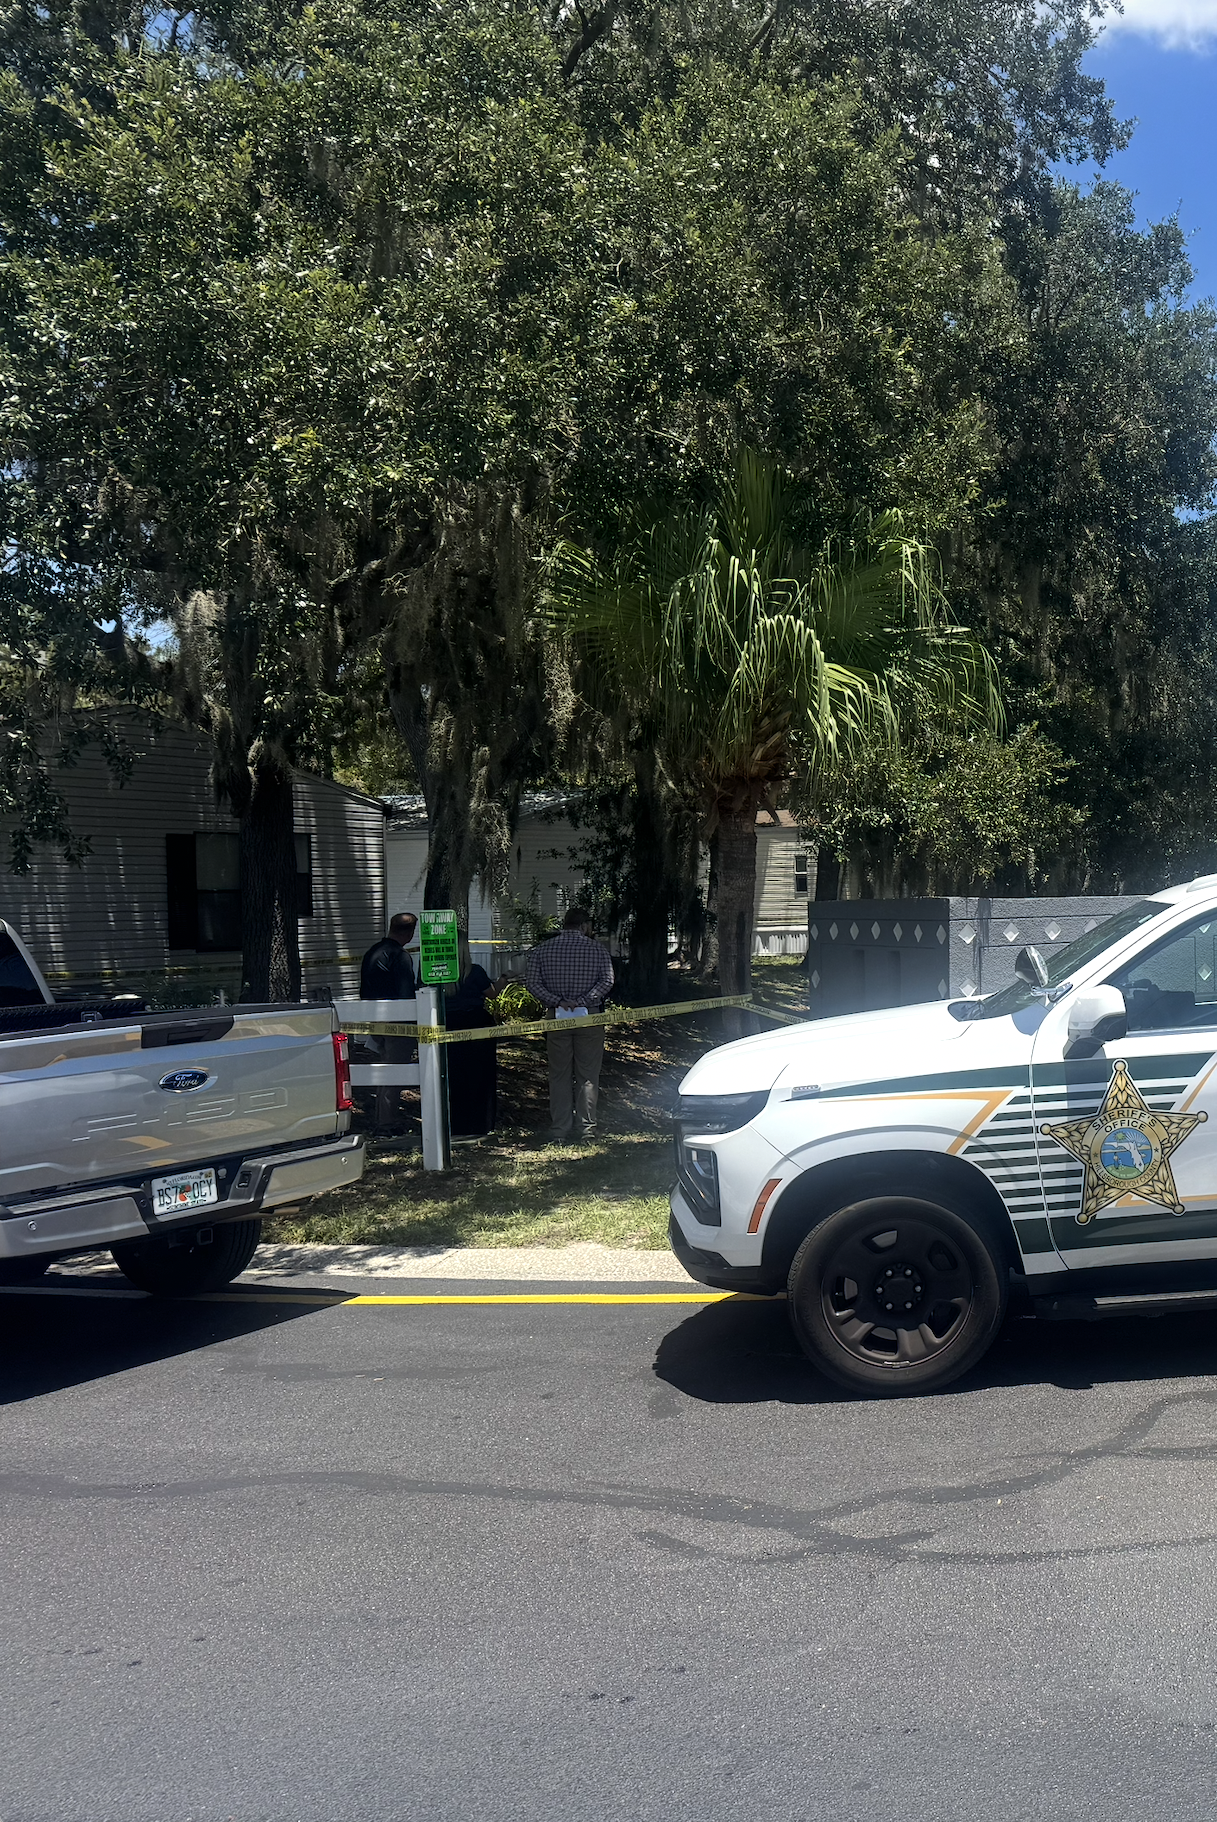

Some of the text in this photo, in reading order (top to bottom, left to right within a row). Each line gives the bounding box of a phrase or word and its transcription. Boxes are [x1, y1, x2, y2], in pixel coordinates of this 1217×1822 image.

[431, 924, 447, 935] ZONE
[72, 1087, 288, 1142] F-150
[1092, 1109, 1158, 1131] SHERIFF'S
[1104, 1119, 1146, 1133] OFFICE
[1094, 1162, 1139, 1188] HILLSBOROUGH
[1140, 1158, 1160, 1183] COUNTY
